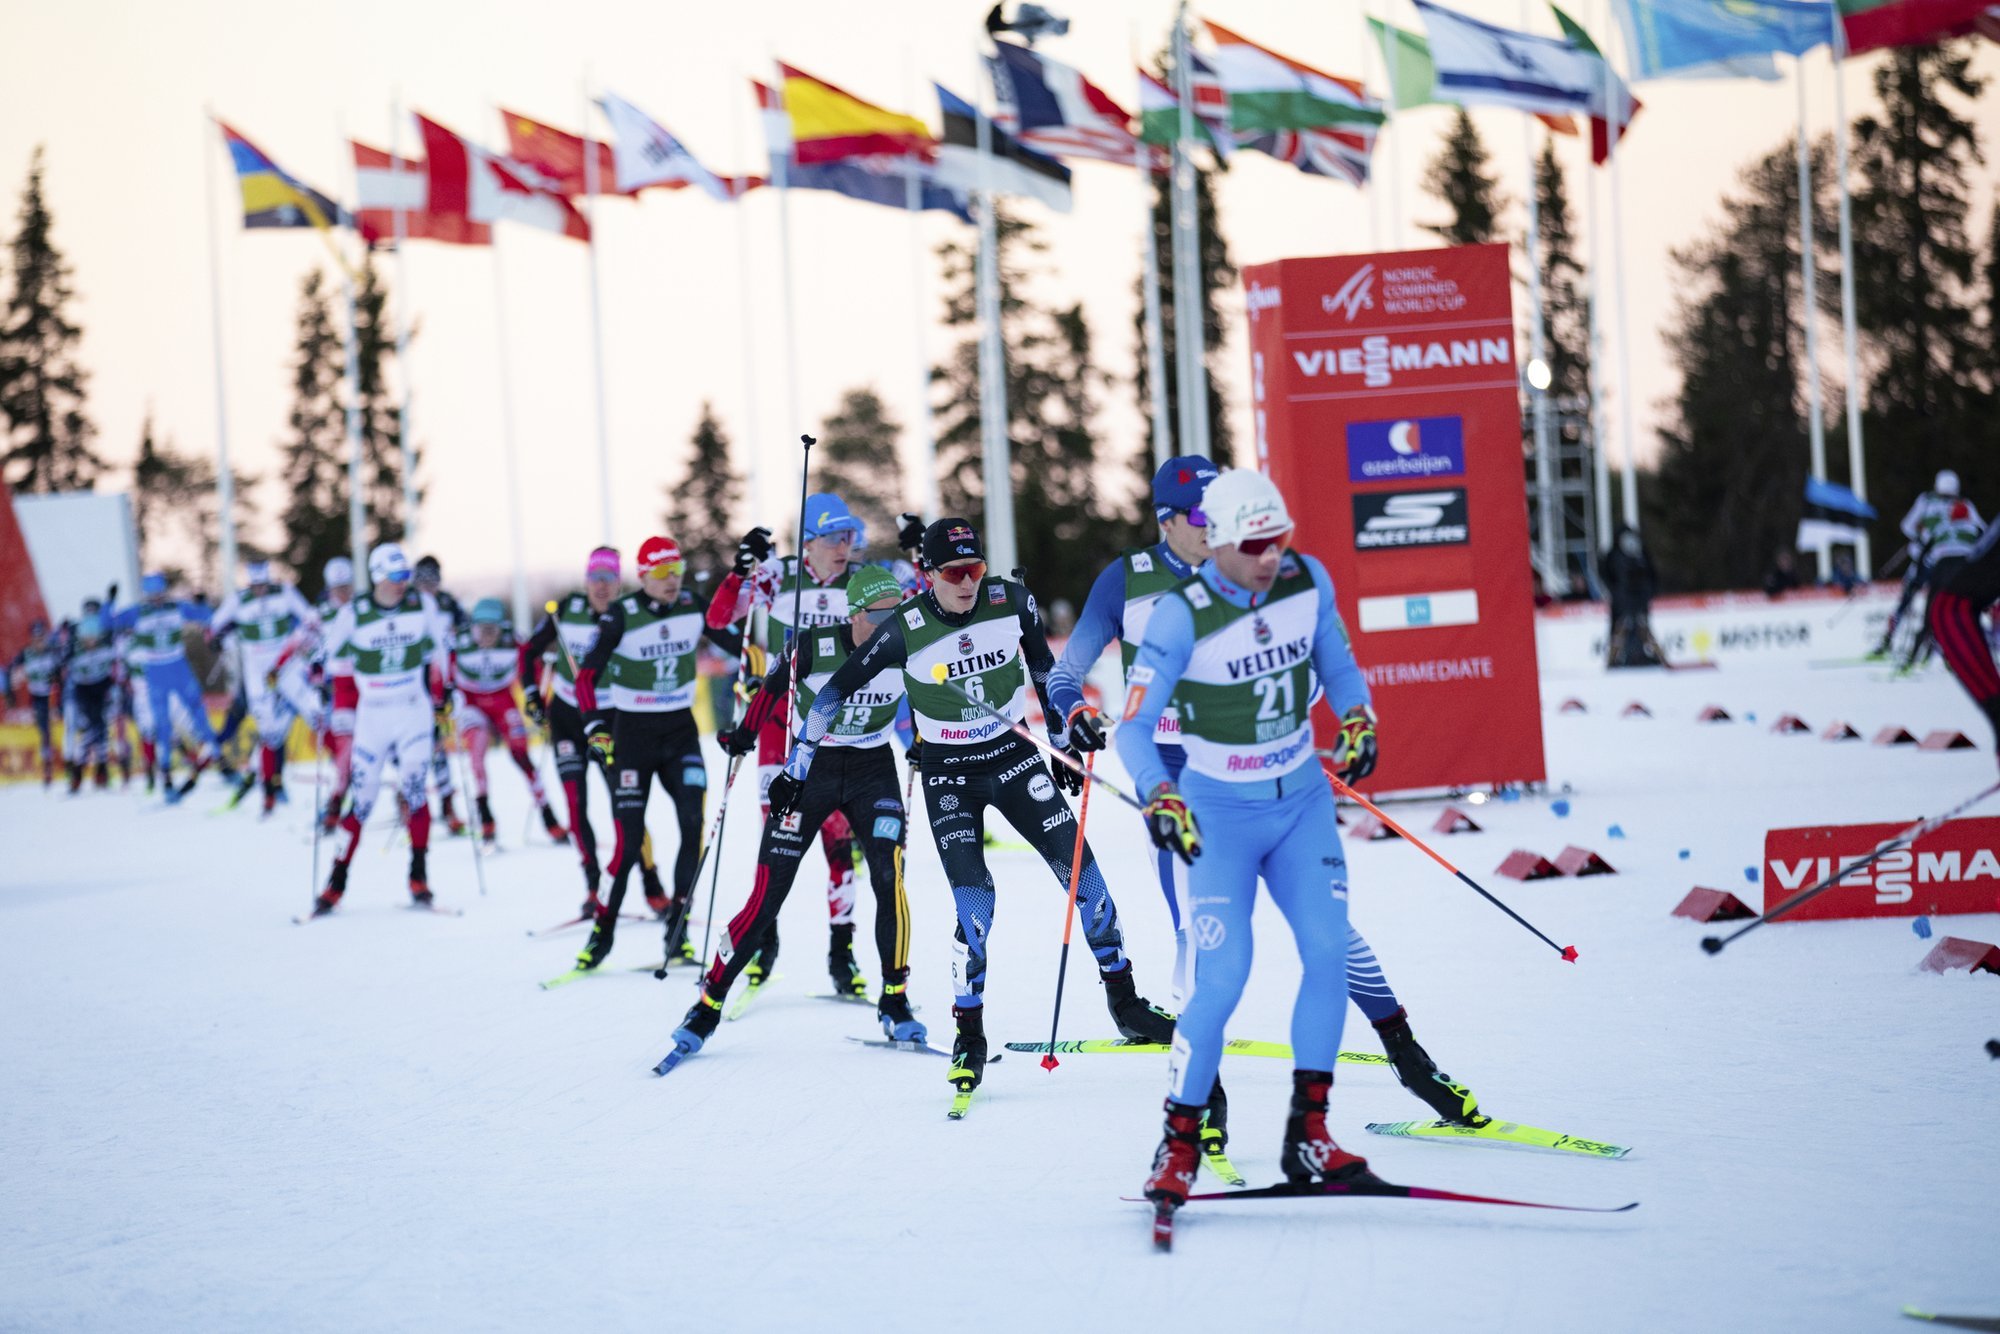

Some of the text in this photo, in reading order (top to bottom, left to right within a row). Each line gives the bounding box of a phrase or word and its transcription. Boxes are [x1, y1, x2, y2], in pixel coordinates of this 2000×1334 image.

[1382, 266, 1437, 281] NORDIC
[1383, 280, 1458, 298] COMBINED
[1384, 294, 1467, 313] WORLD CUP
[1293, 335, 1509, 387] VIESSMANN
[1362, 453, 1452, 476] azerbaijan
[653, 657, 678, 681] 12
[946, 649, 1006, 678] ELTINS
[1227, 637, 1308, 679] VELTINS
[848, 692, 893, 705] LTINS
[964, 675, 985, 706] 6
[1253, 669, 1295, 721] 21
[842, 706, 872, 727] 13
